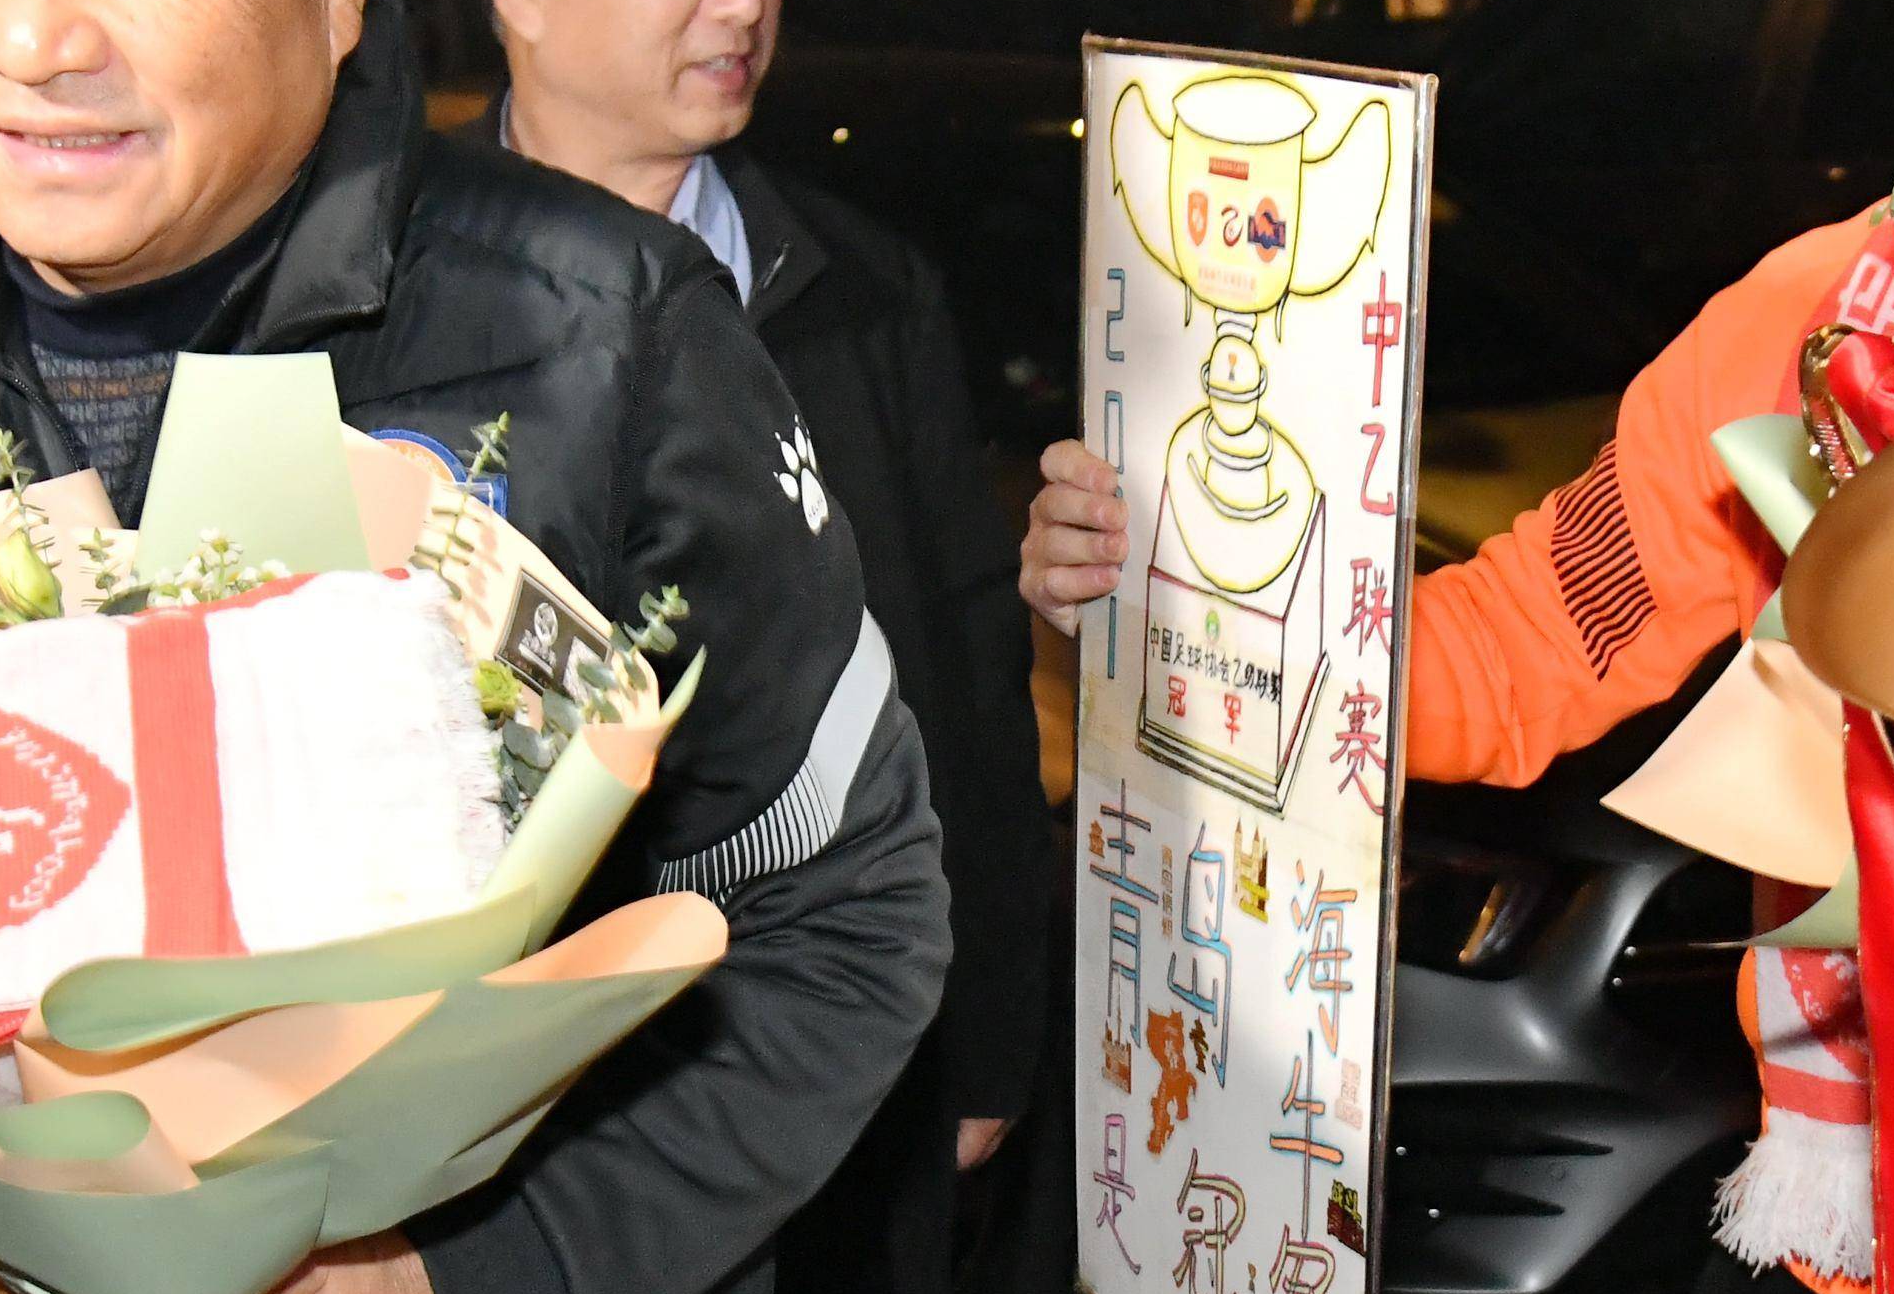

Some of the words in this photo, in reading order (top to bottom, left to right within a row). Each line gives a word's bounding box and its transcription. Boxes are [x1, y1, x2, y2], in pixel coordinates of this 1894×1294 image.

[1104, 268, 1126, 681] 201
[1332, 270, 1403, 816] 中乙联赛
